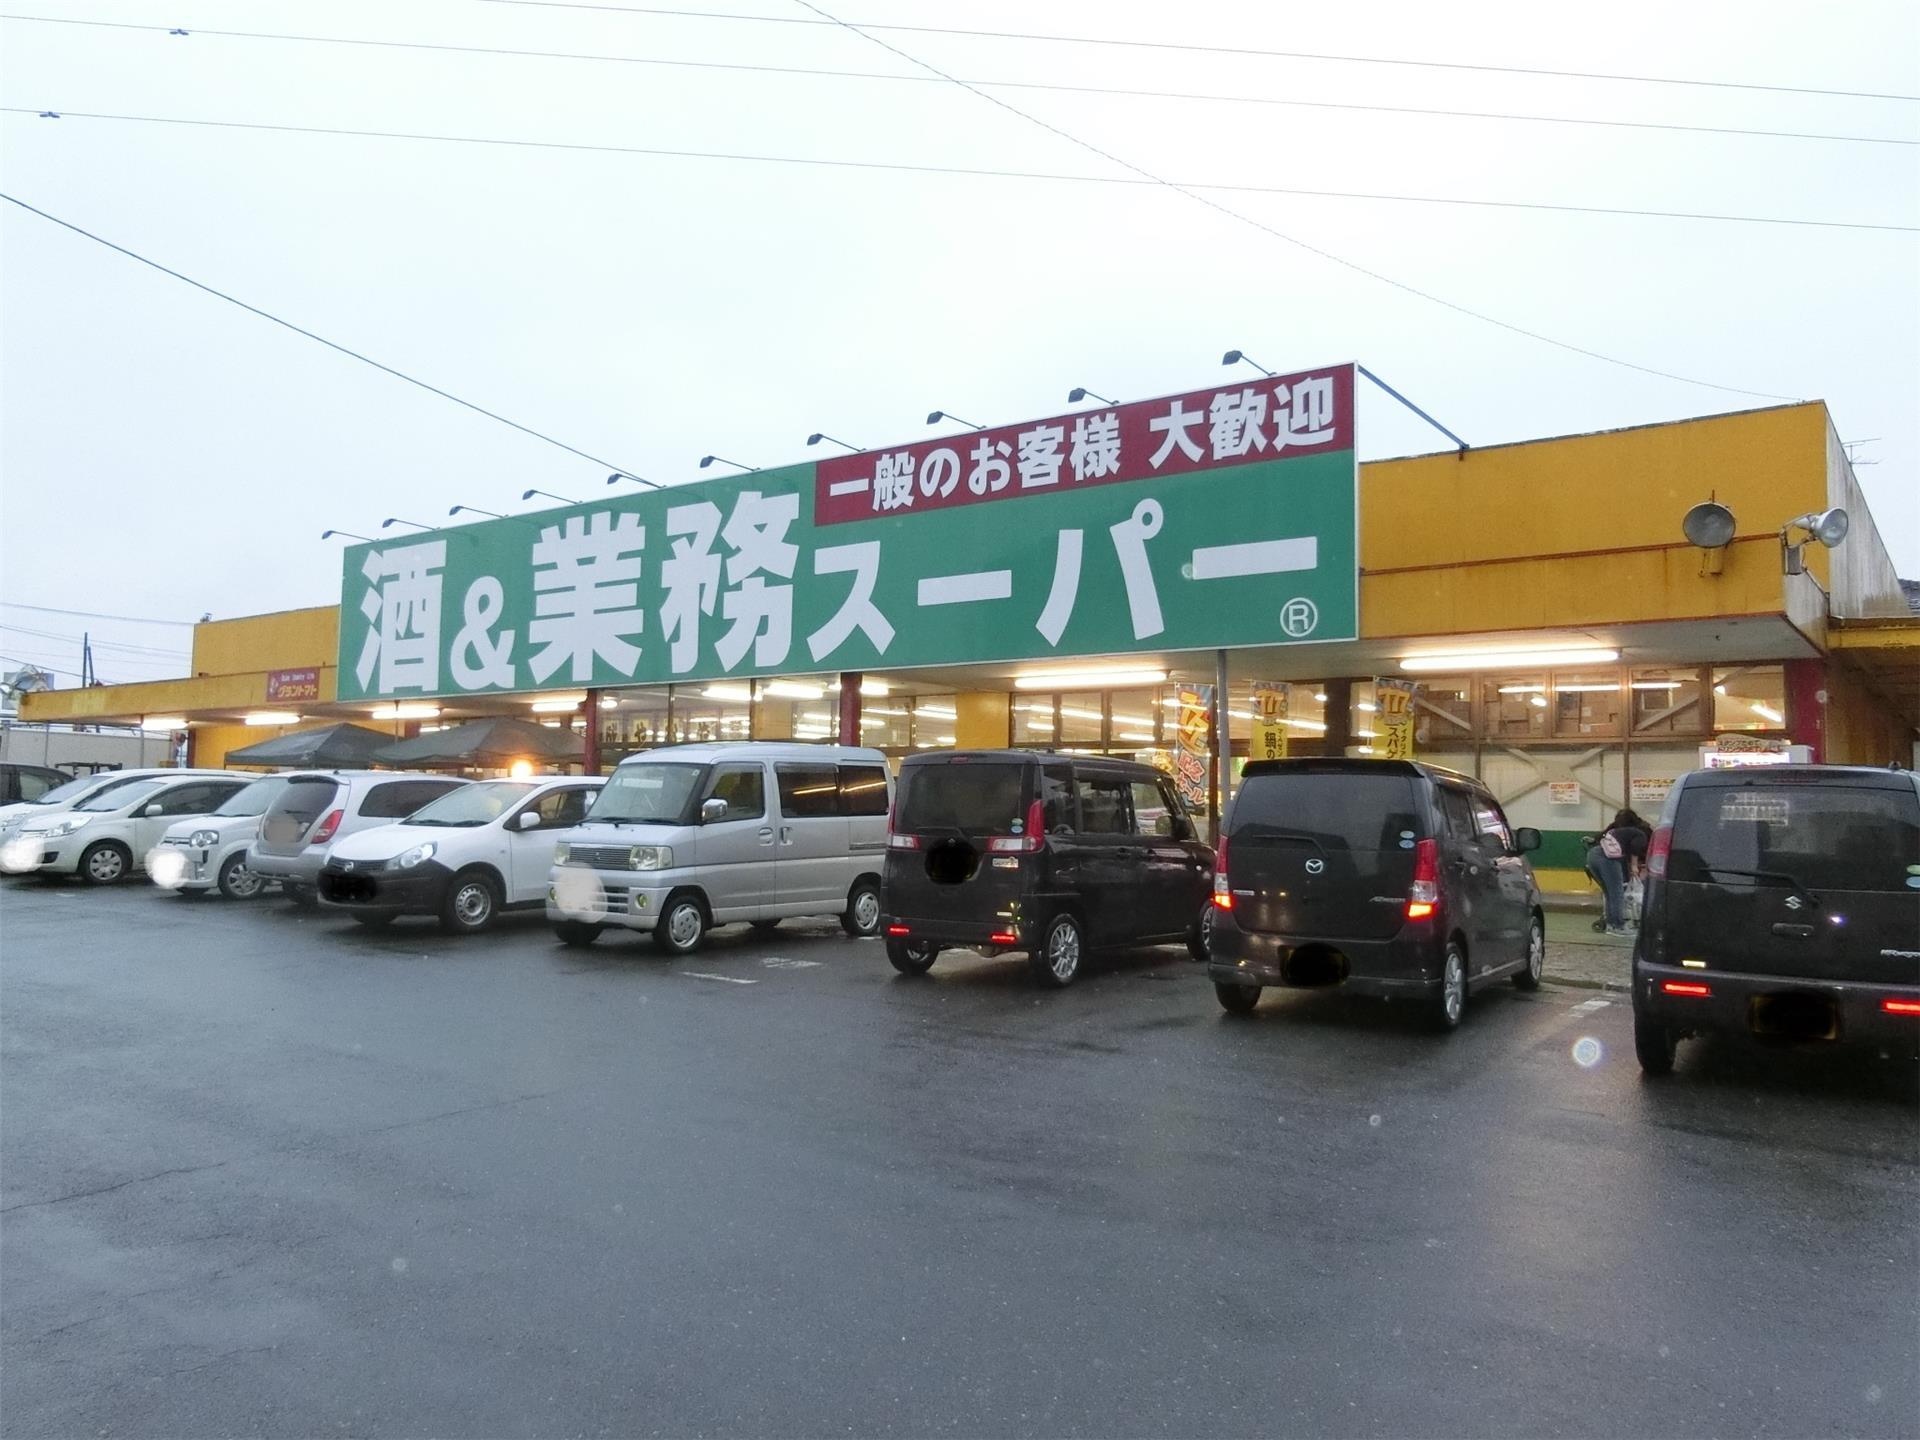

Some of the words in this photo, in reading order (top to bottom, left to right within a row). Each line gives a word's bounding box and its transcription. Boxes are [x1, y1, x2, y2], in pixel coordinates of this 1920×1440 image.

[829, 411, 1122, 512] 一般のお客様
[1148, 376, 1336, 471] 大歓迎
[356, 490, 1318, 695] 酒&業務スーパー
[278, 684, 318, 698] グラントマト
